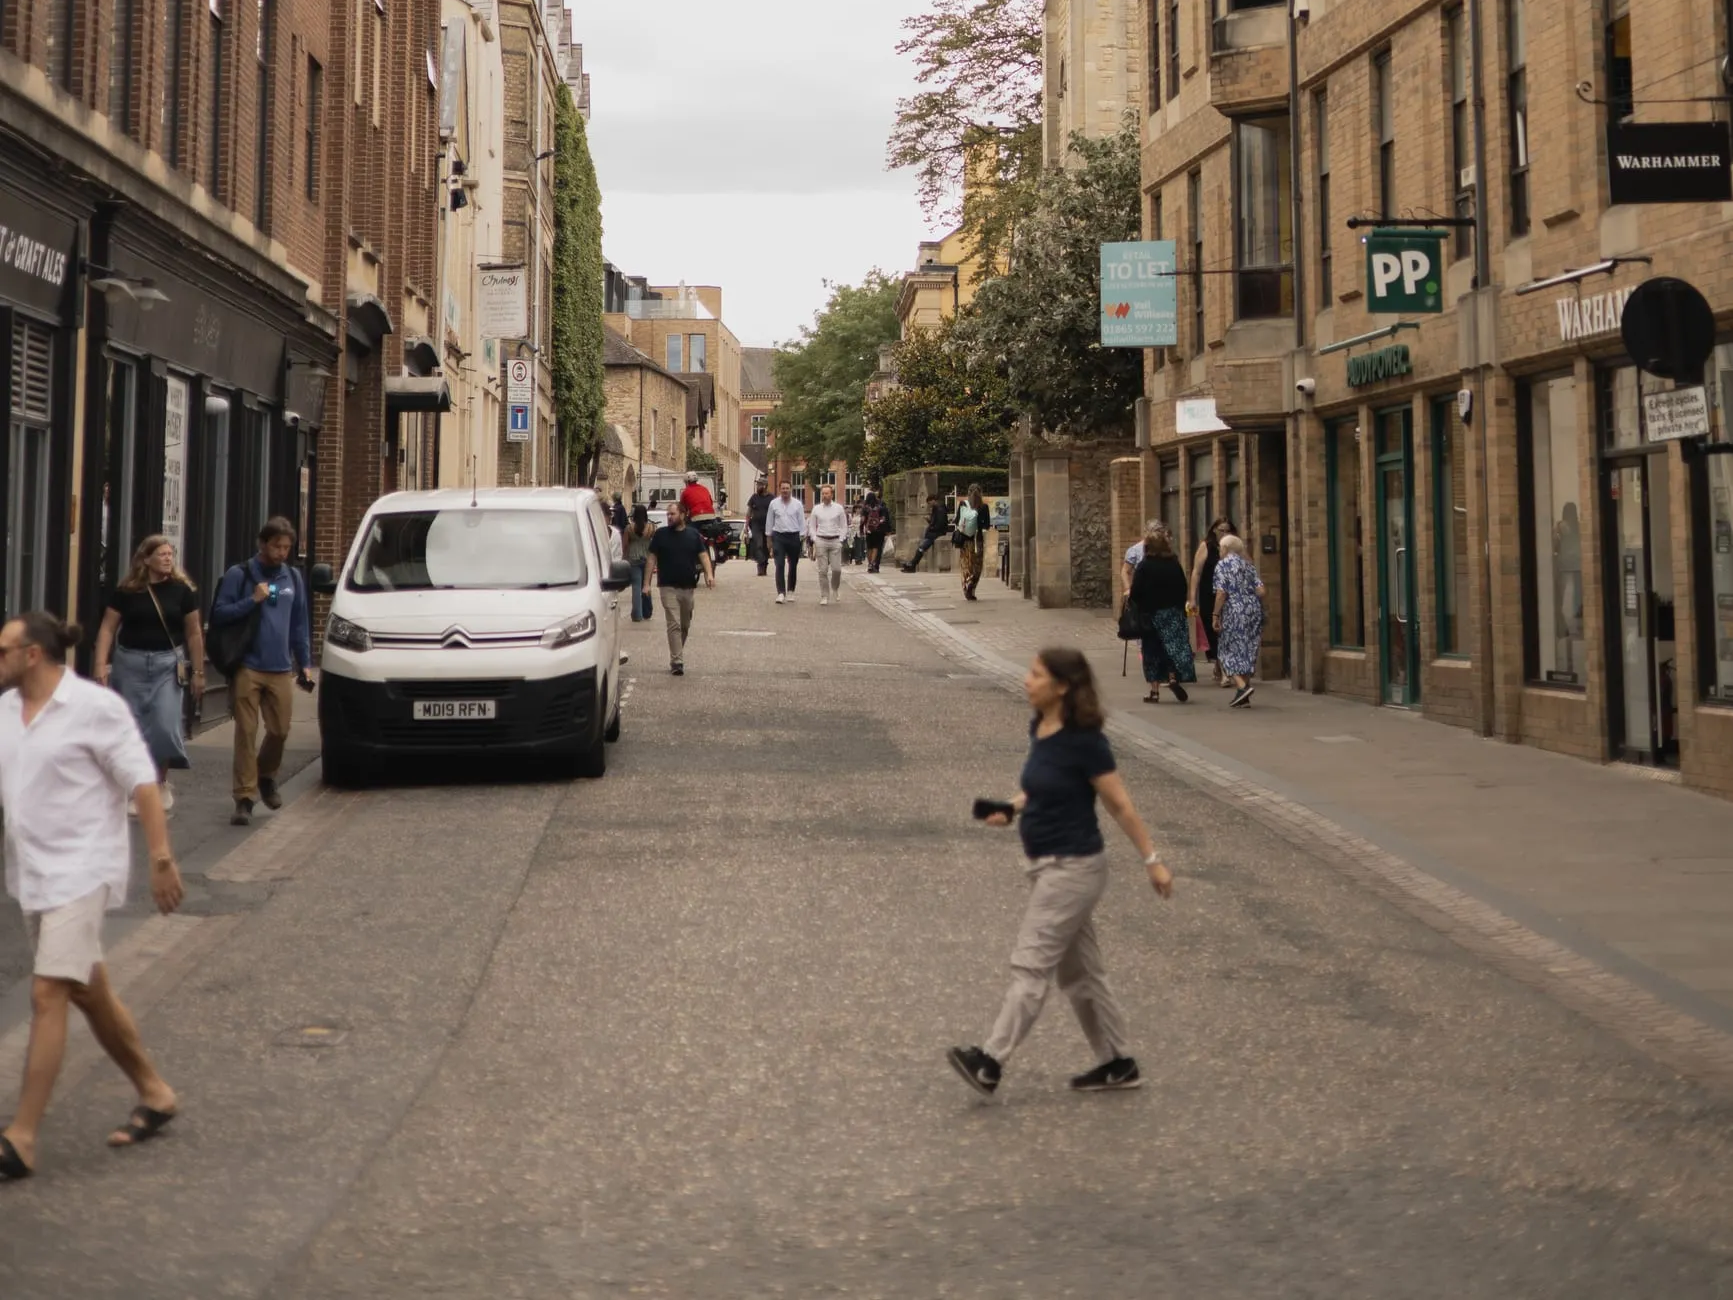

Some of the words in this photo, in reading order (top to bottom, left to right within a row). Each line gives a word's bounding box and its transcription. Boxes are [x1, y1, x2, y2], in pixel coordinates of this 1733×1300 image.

[14, 235, 46, 277] CRAFT
[41, 248, 66, 286] ALES
[1106, 262, 1132, 279] TO
[1138, 261, 1170, 279] LET
[1104, 324, 1133, 334] 01865
[1135, 324, 1153, 334] 597
[1156, 323, 1175, 333] 222
[423, 703, 454, 716] MD19
[459, 703, 486, 716] RFN
